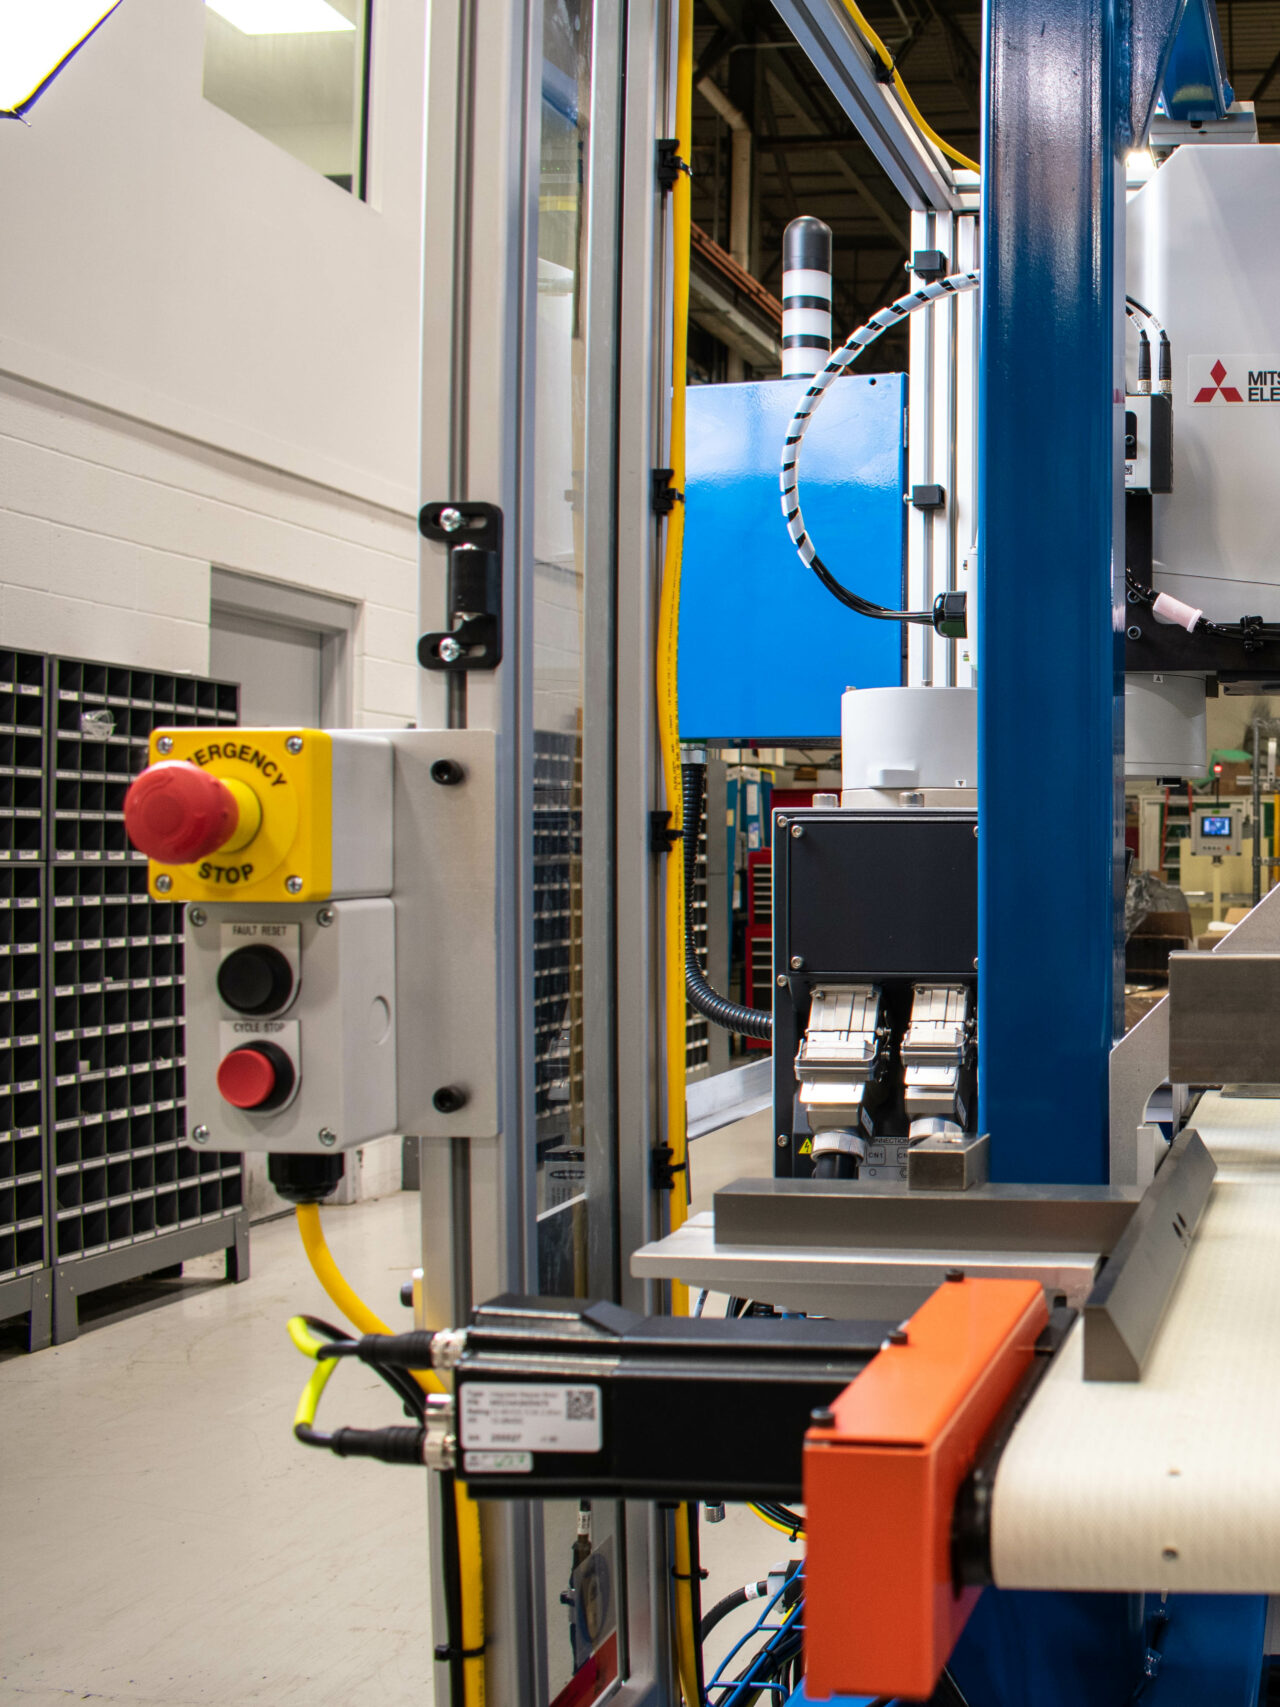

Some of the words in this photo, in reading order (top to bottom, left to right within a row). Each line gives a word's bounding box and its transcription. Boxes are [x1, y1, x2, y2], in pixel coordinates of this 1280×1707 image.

[186, 742, 288, 787] ERGENCY
[198, 862, 254, 884] STOP
[232, 925, 257, 935] FAULT
[261, 926, 287, 936] RESET
[233, 1022, 259, 1032] CYCLE
[263, 1022, 286, 1032] STOP
